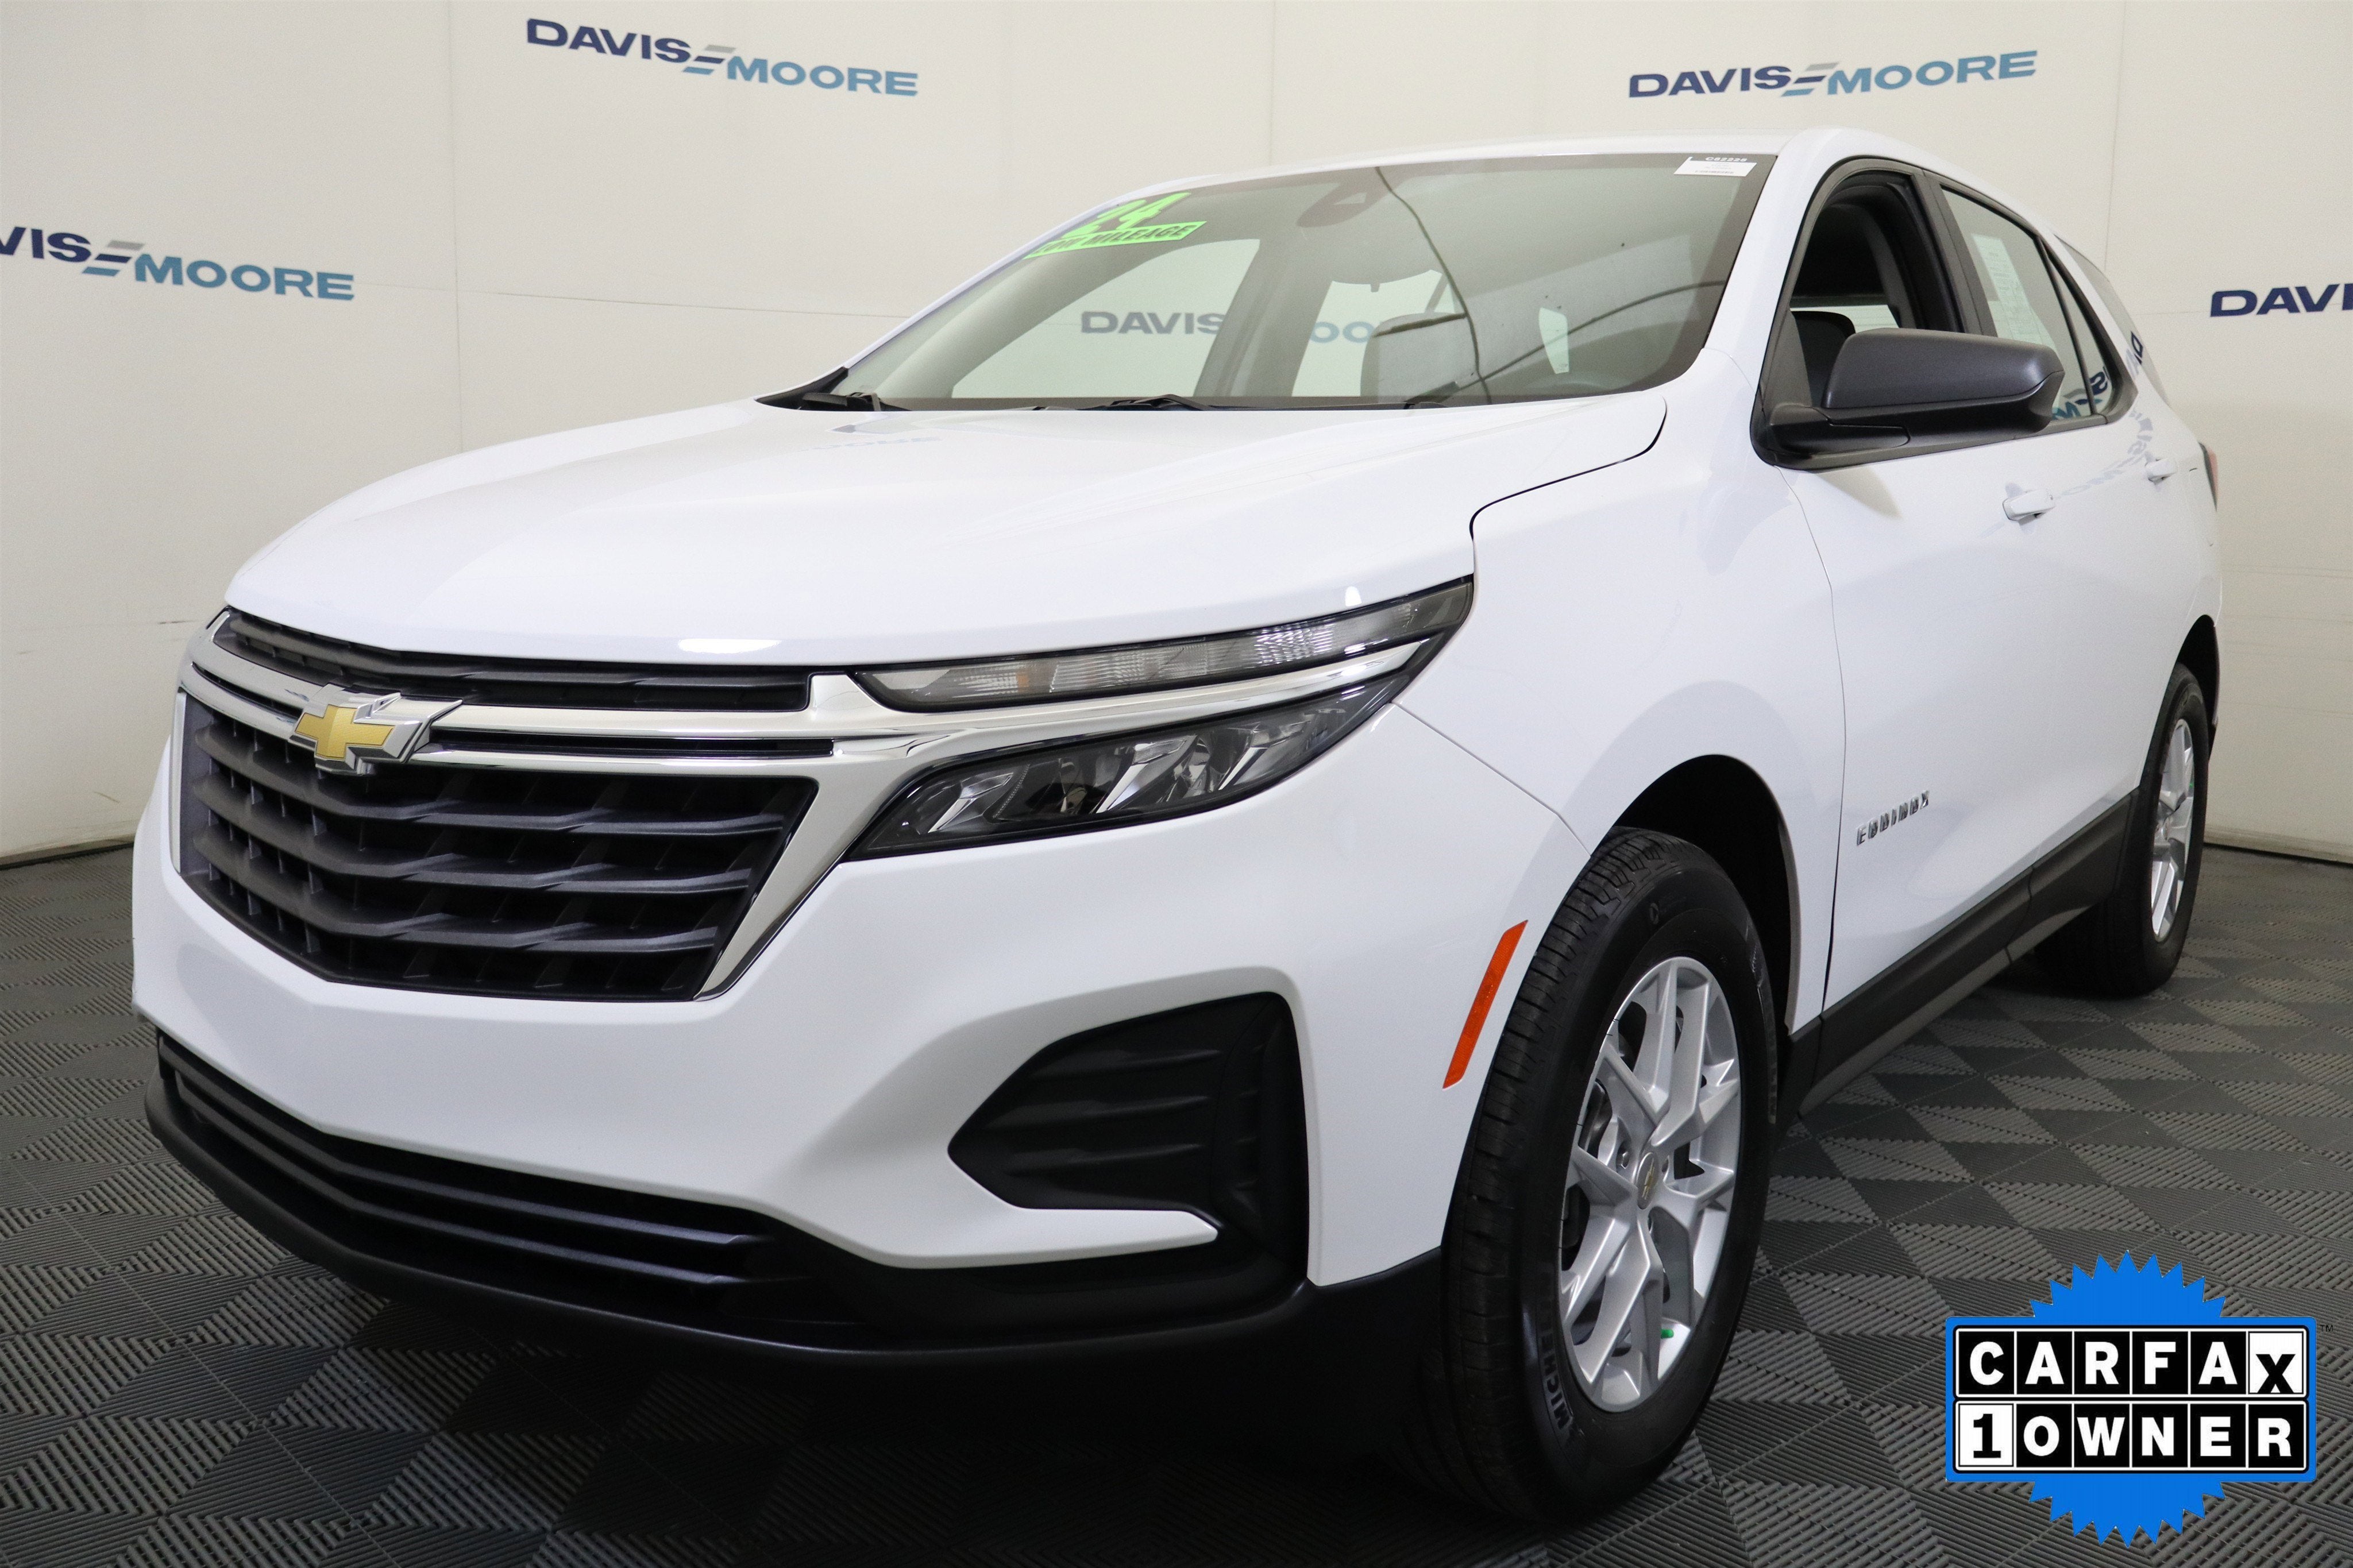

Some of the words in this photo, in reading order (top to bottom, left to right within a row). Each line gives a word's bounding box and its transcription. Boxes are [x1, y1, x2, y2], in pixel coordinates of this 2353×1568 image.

[526, 18, 691, 63] DAVIS
[727, 56, 919, 96] MOORE
[1629, 65, 1792, 98] DAVIS
[1827, 50, 2038, 96] MOORE
[1081, 225, 1198, 246] MILEAGE
[134, 253, 354, 301] MOORE
[1081, 311, 1226, 334] DAVIS
